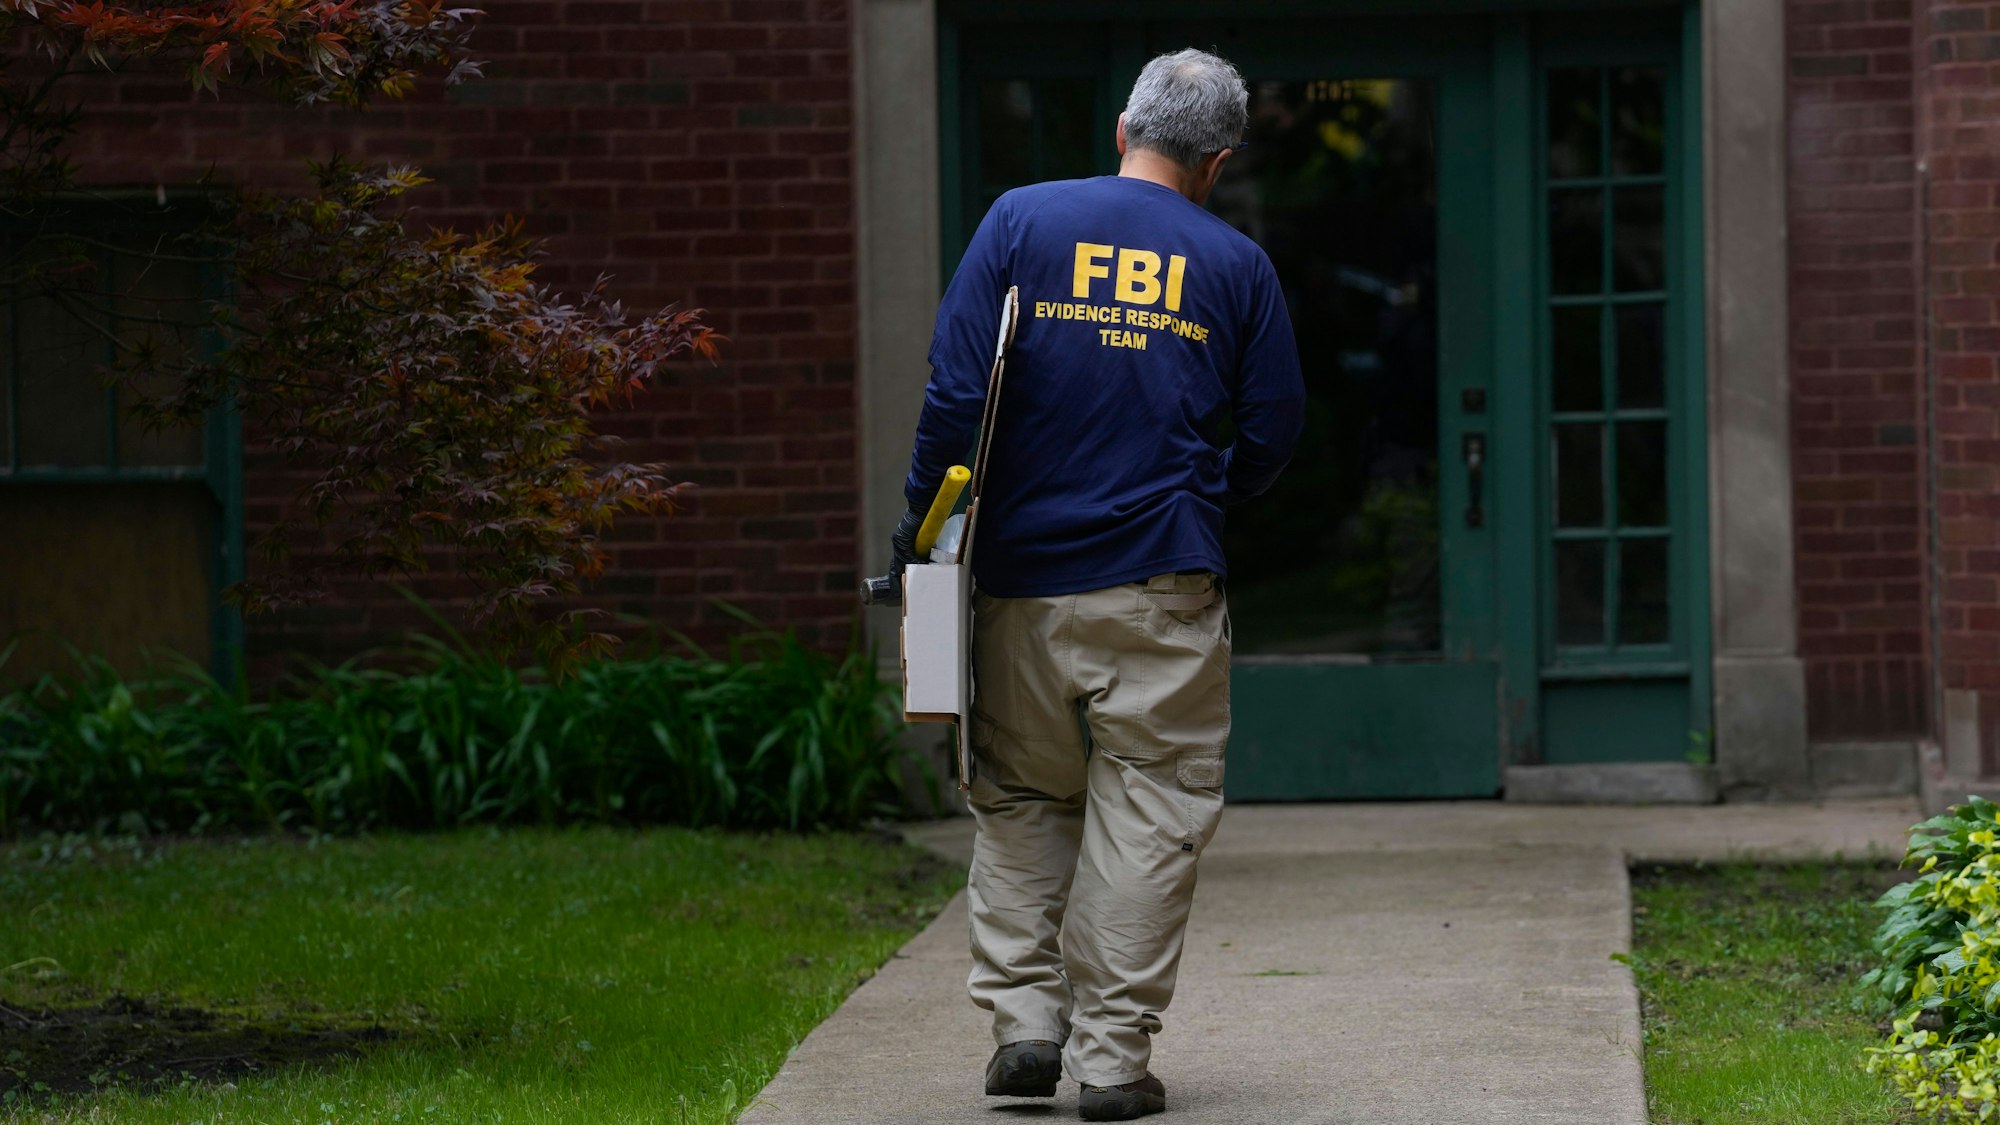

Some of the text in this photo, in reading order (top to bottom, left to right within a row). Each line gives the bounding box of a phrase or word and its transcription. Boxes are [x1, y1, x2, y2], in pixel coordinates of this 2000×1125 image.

[1073, 242, 1187, 312] FBI
[1035, 302, 1209, 344] EVIDENCE RESPONSE
[1099, 329, 1148, 350] TEAM
